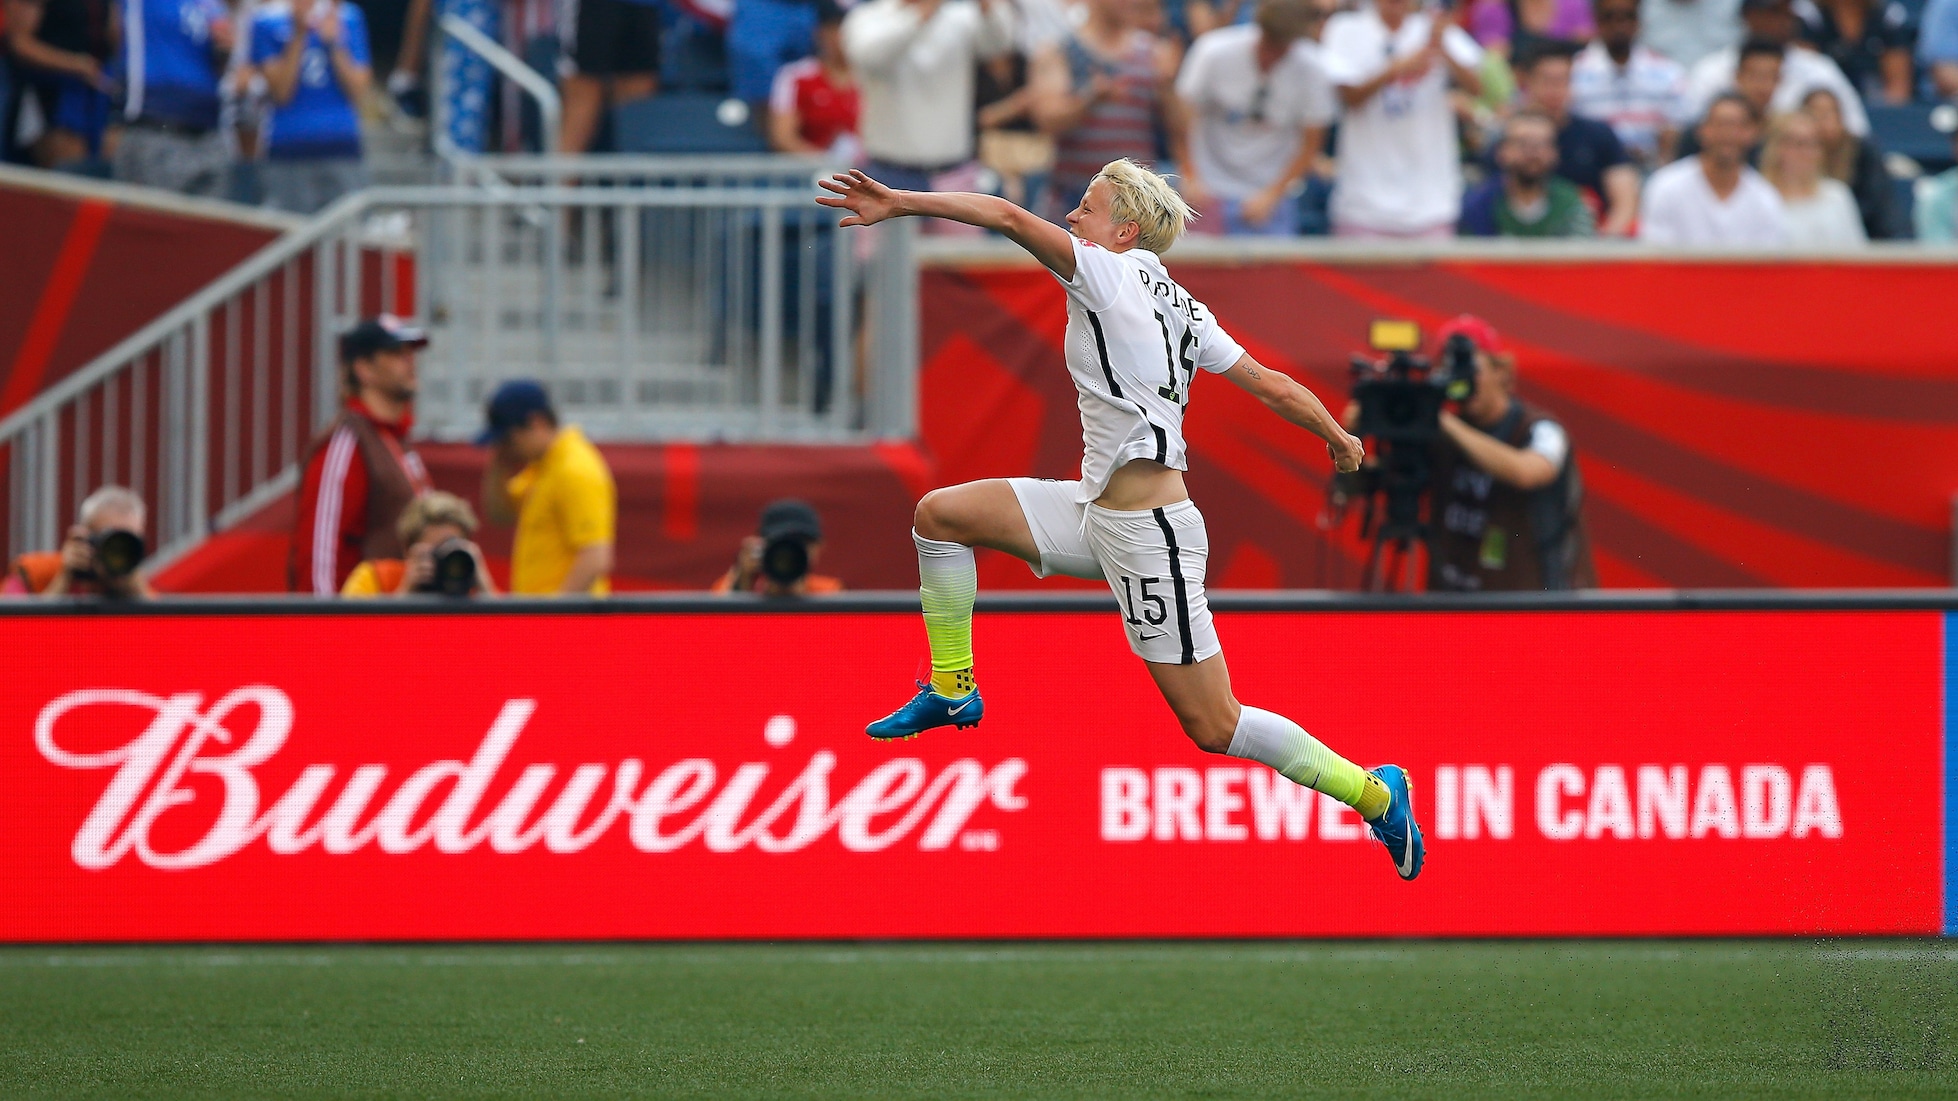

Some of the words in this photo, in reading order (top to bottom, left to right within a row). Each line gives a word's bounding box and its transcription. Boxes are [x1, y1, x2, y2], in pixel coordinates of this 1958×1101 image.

[1153, 308, 1199, 416] 15
[1120, 575, 1168, 626] 15
[33, 684, 1027, 870] Budweiser
[1100, 766, 1412, 841] BREWE
[1434, 766, 1513, 840] IN
[1536, 763, 1843, 840] CANADA
